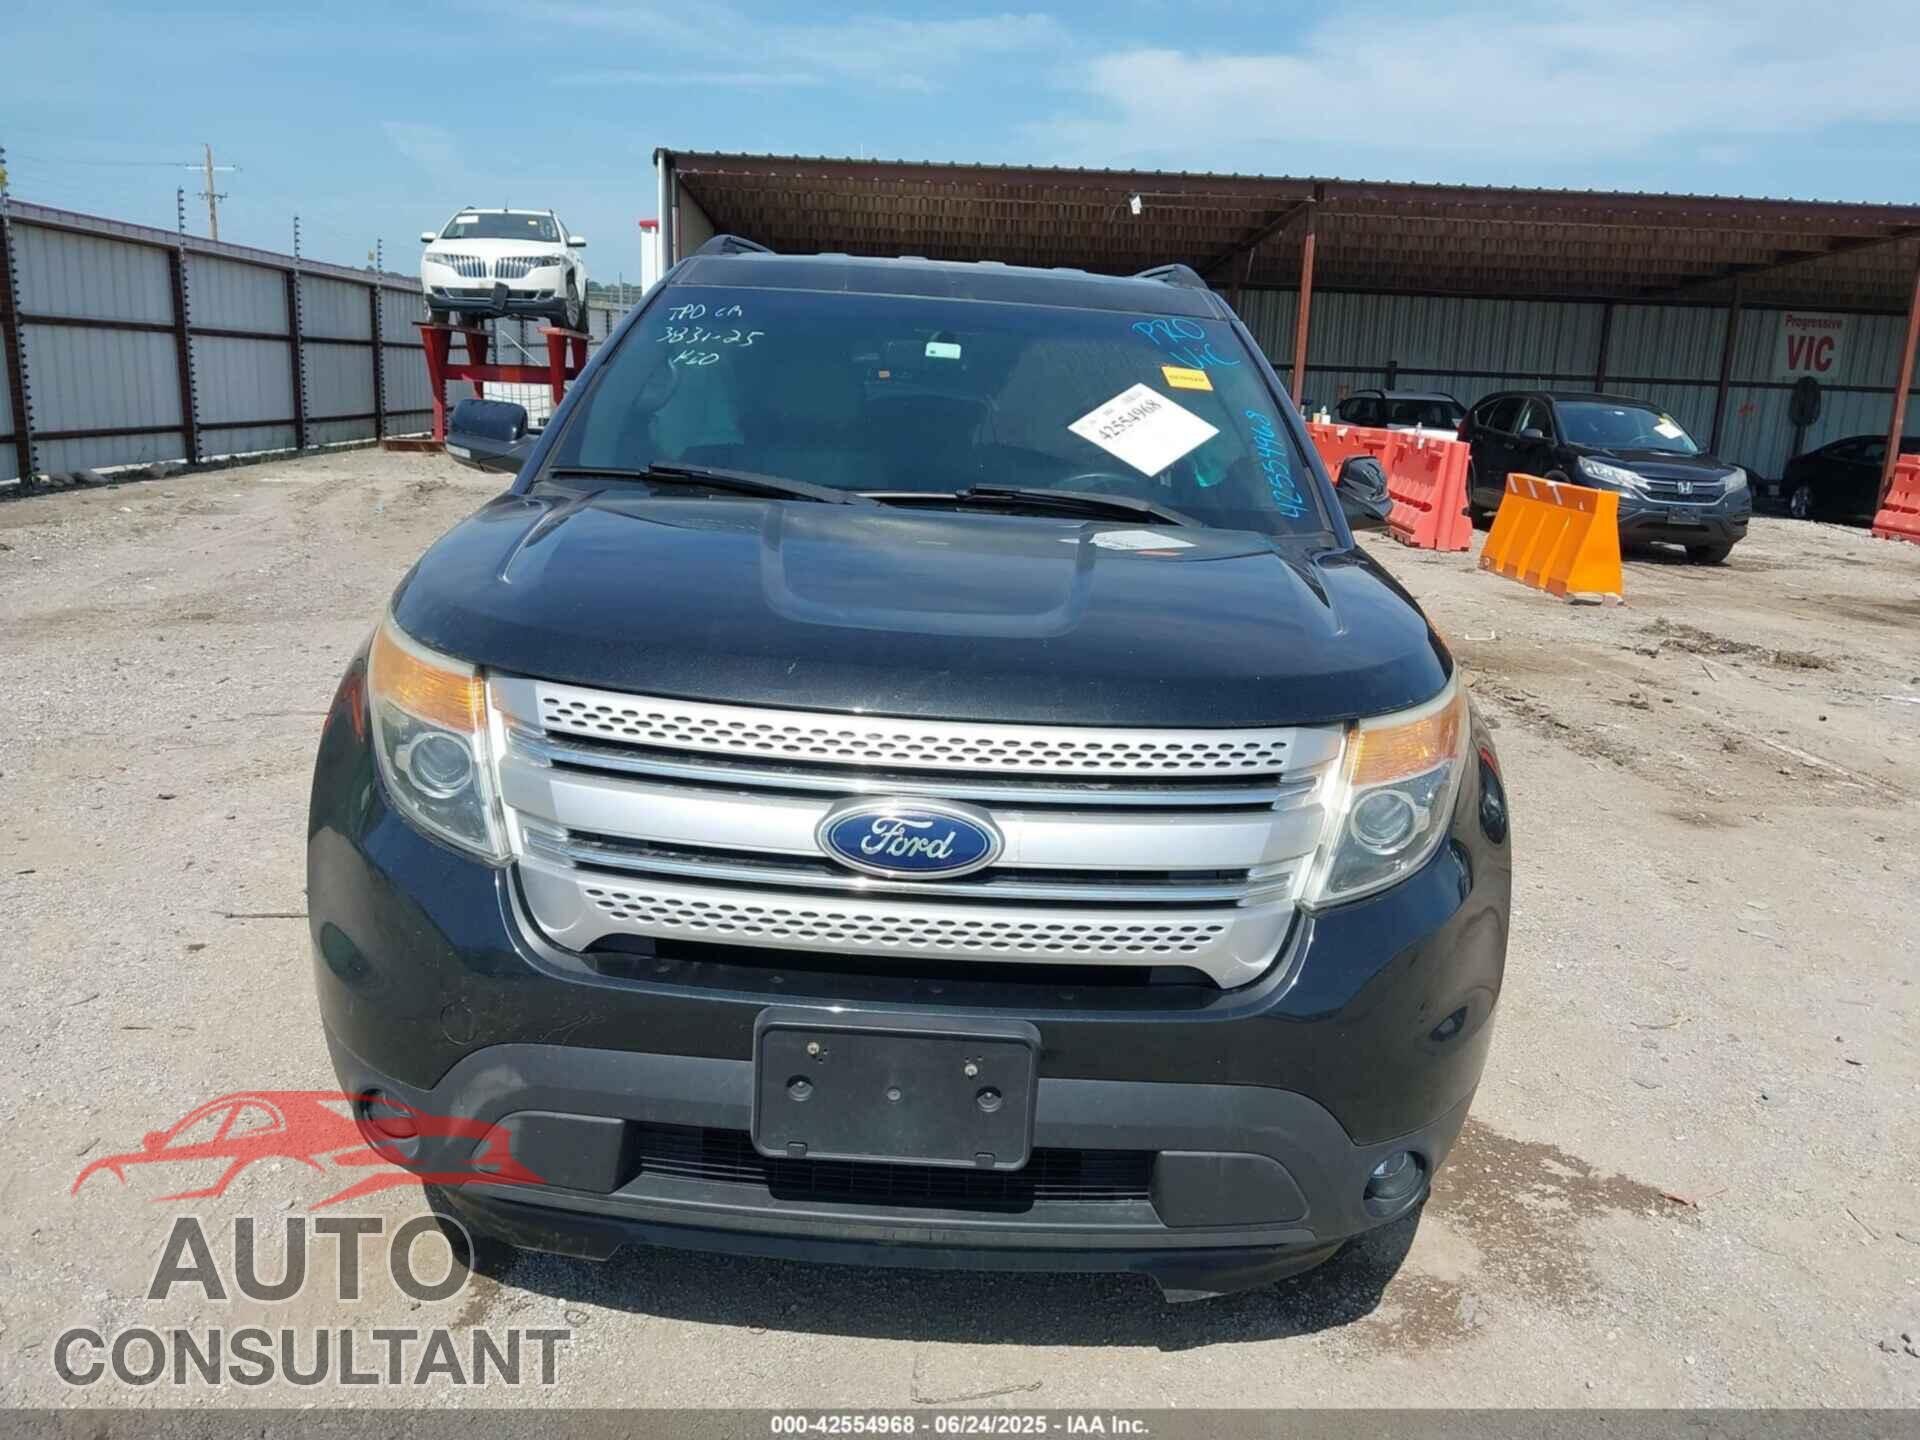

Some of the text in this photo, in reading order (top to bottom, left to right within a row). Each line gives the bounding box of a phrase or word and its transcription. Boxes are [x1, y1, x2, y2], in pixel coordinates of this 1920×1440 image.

[656, 326, 765, 347] 3831-25
[1132, 318, 1206, 345] PRO
[1787, 335, 1834, 372] VIC
[1098, 399, 1162, 441] 42554968
[1244, 408, 1310, 519] 42554968
[861, 817, 956, 859] Ford
